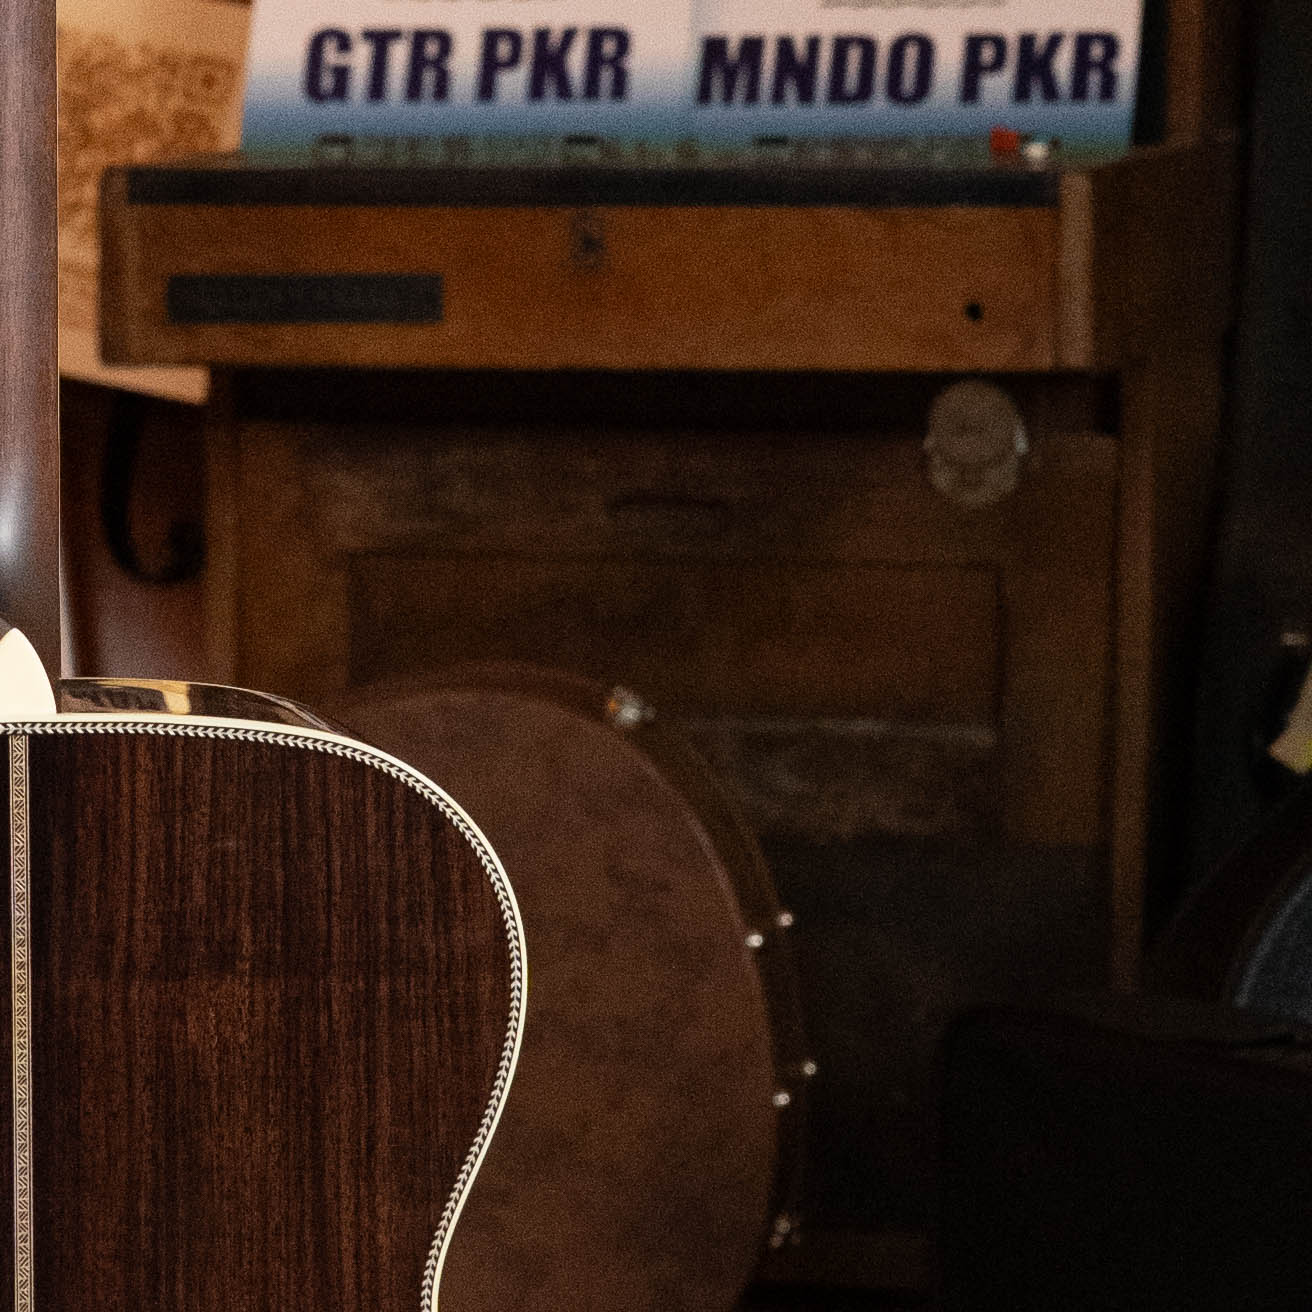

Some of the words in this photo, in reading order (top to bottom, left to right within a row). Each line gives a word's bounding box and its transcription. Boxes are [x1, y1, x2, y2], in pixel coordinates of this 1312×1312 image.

[304, 25, 454, 104] GTR
[475, 24, 632, 104] PKR
[696, 31, 937, 106] MNDO
[957, 31, 1121, 105] PKR
